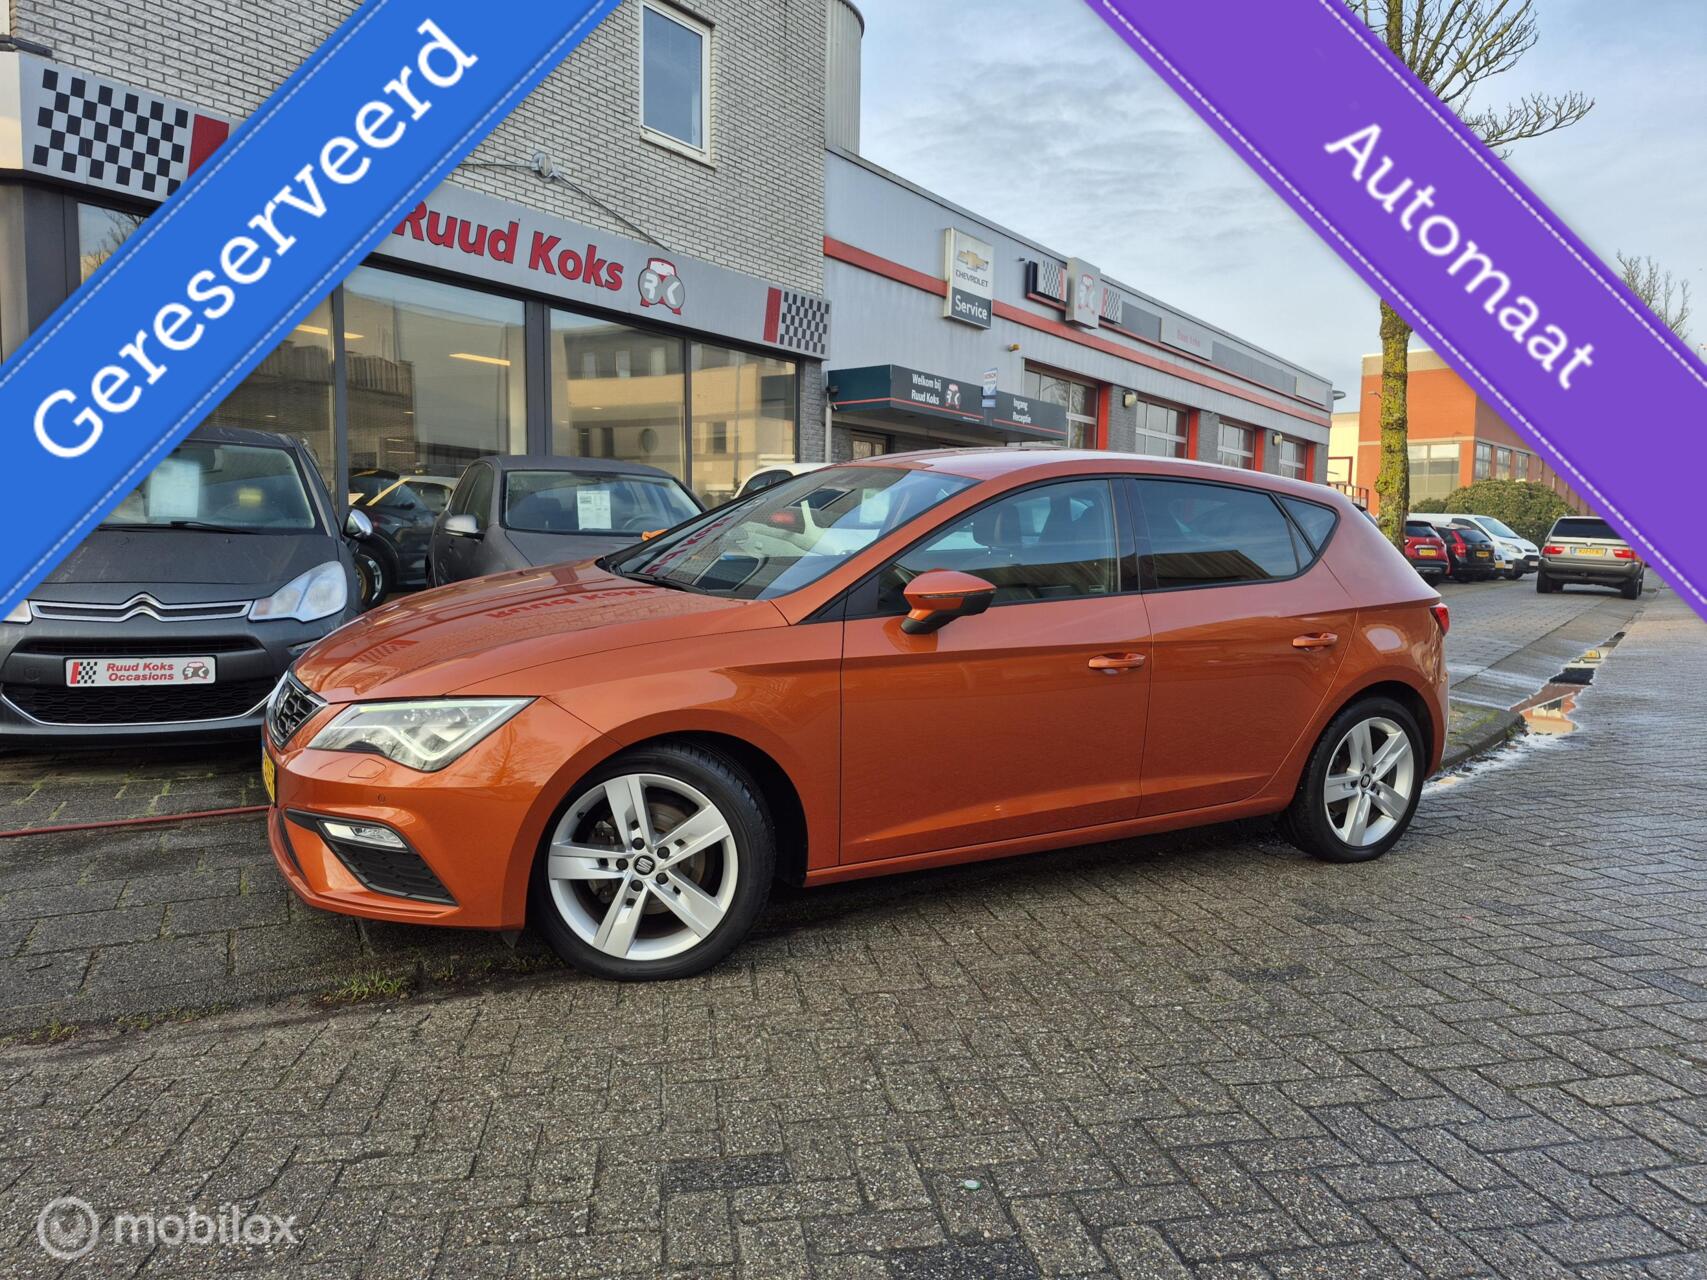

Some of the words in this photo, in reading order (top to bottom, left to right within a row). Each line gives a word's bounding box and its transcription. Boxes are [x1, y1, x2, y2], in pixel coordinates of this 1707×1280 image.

[392, 201, 520, 264] Ruud
[528, 230, 625, 292] Koks
[955, 269, 989, 288] CHEVROLET
[955, 294, 988, 320] Service
[911, 373, 933, 389] Welkom
[911, 389, 925, 403] Ruud
[926, 392, 940, 405] Koks
[106, 662, 140, 672] Ruud
[142, 662, 174, 671] Koks
[108, 672, 174, 682] Occasions
